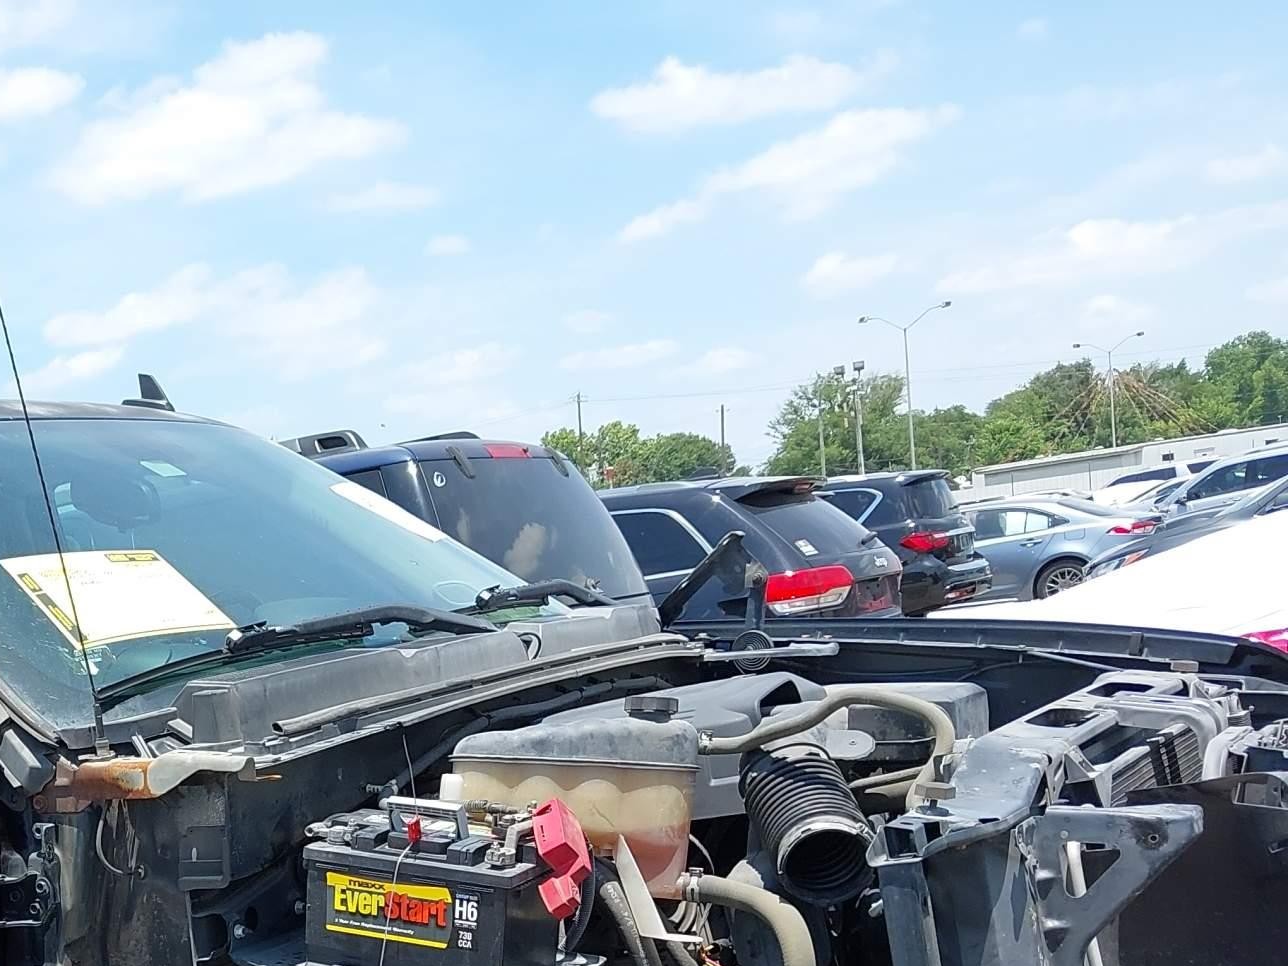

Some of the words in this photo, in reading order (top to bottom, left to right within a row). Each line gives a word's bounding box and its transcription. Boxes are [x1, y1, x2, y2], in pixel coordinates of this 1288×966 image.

[348, 879, 386, 891] maxx
[333, 883, 448, 927] EverStart
[454, 899, 478, 922] H6
[457, 939, 472, 949] CCA
